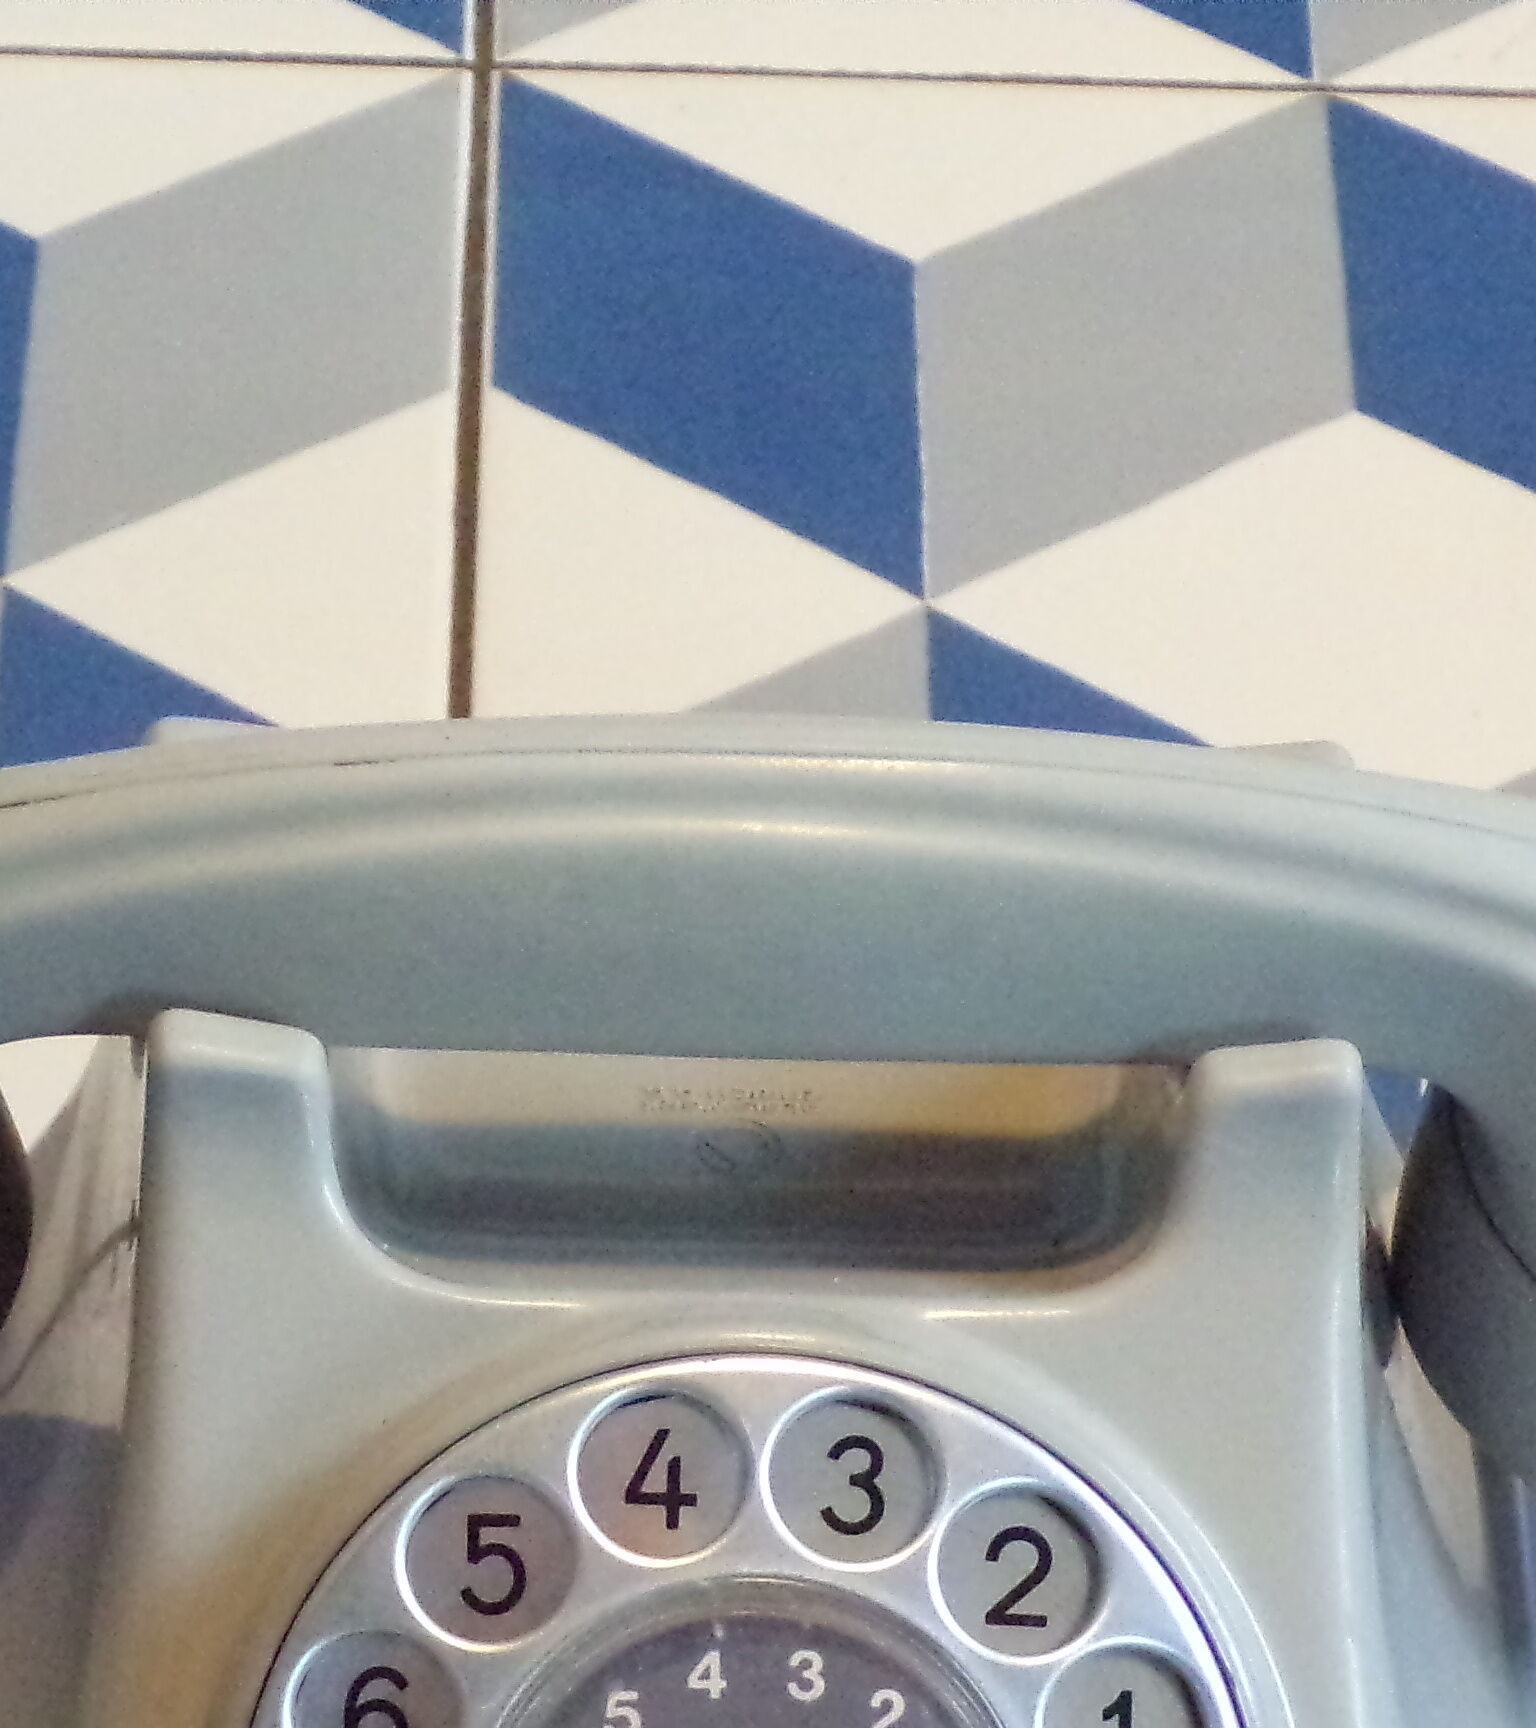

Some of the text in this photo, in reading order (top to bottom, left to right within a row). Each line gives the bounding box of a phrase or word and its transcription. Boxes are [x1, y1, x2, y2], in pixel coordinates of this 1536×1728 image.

[625, 1428, 697, 1530] 4
[821, 1434, 883, 1534] 3
[461, 1512, 526, 1615] 5
[985, 1526, 1053, 1629] 2
[687, 1652, 727, 1699] 4
[787, 1650, 826, 1701] 3
